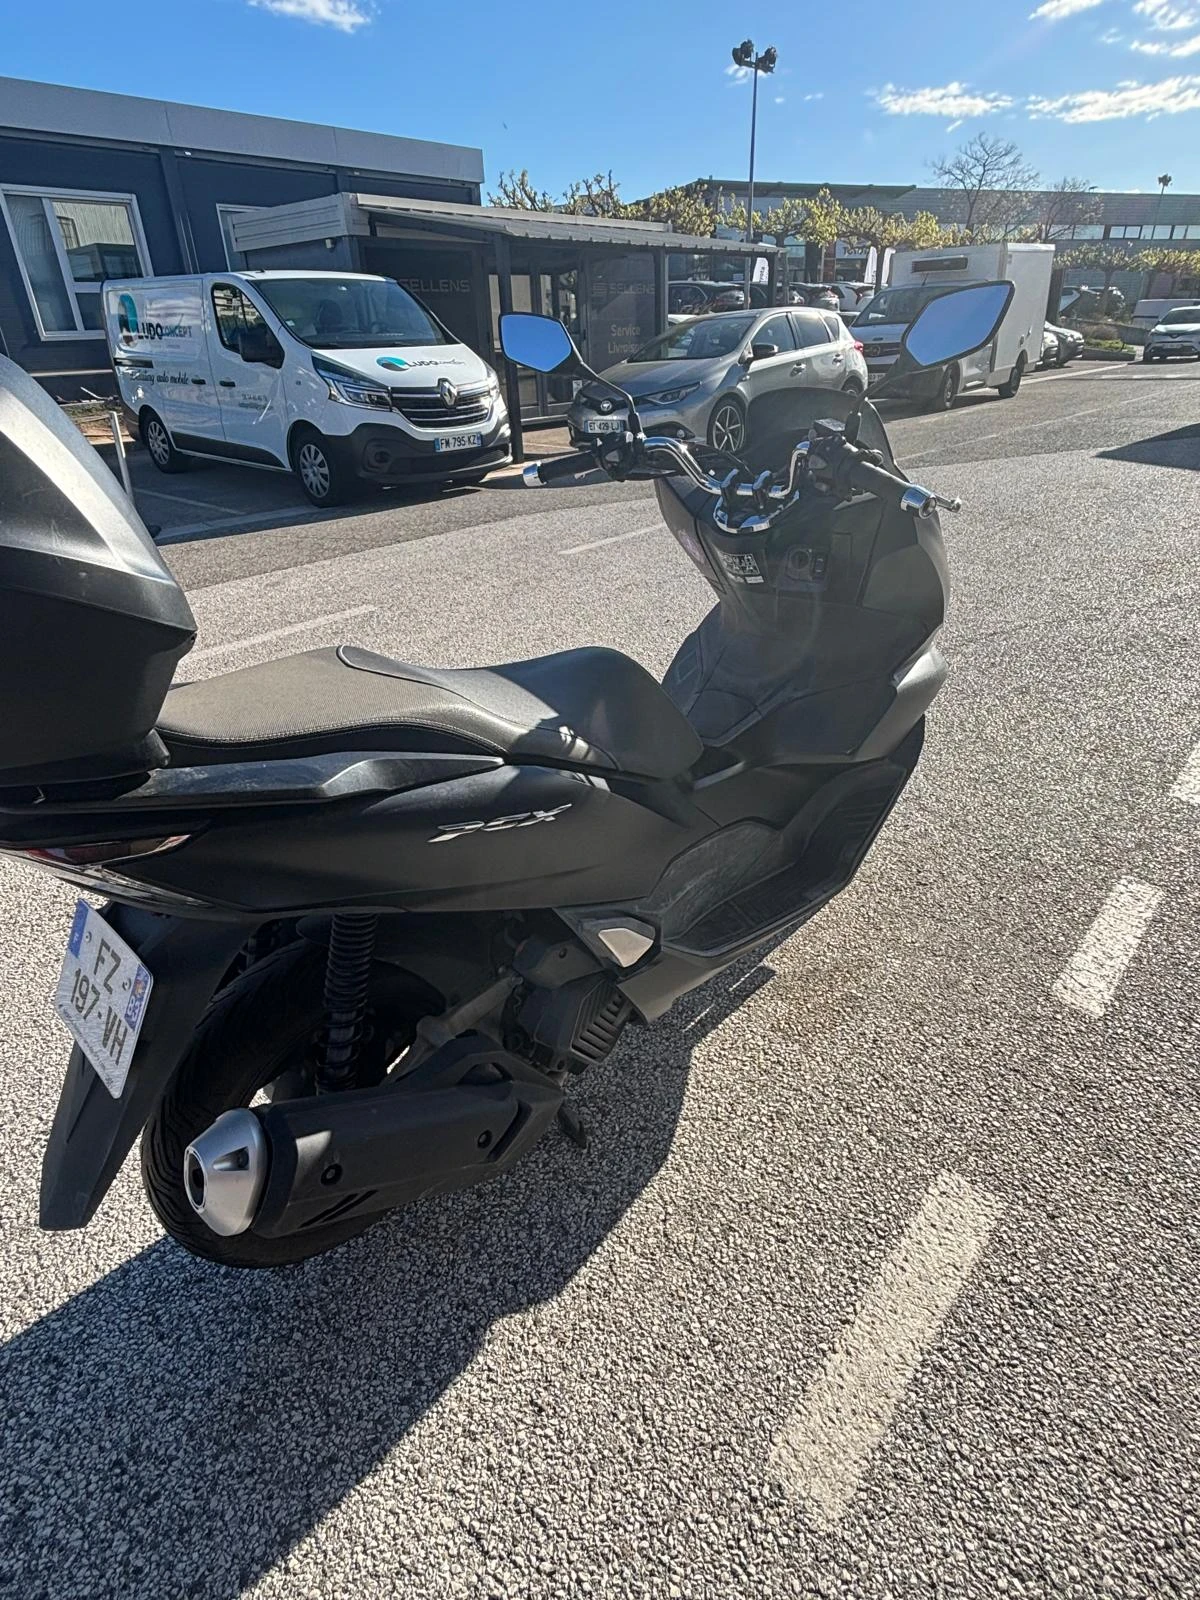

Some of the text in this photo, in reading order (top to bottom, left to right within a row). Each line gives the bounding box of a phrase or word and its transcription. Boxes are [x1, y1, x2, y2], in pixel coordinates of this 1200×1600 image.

[611, 324, 640, 336] Service
[427, 803, 572, 843] PCX
[93, 938, 121, 995] FZ
[71, 968, 128, 1066] 197-VH
